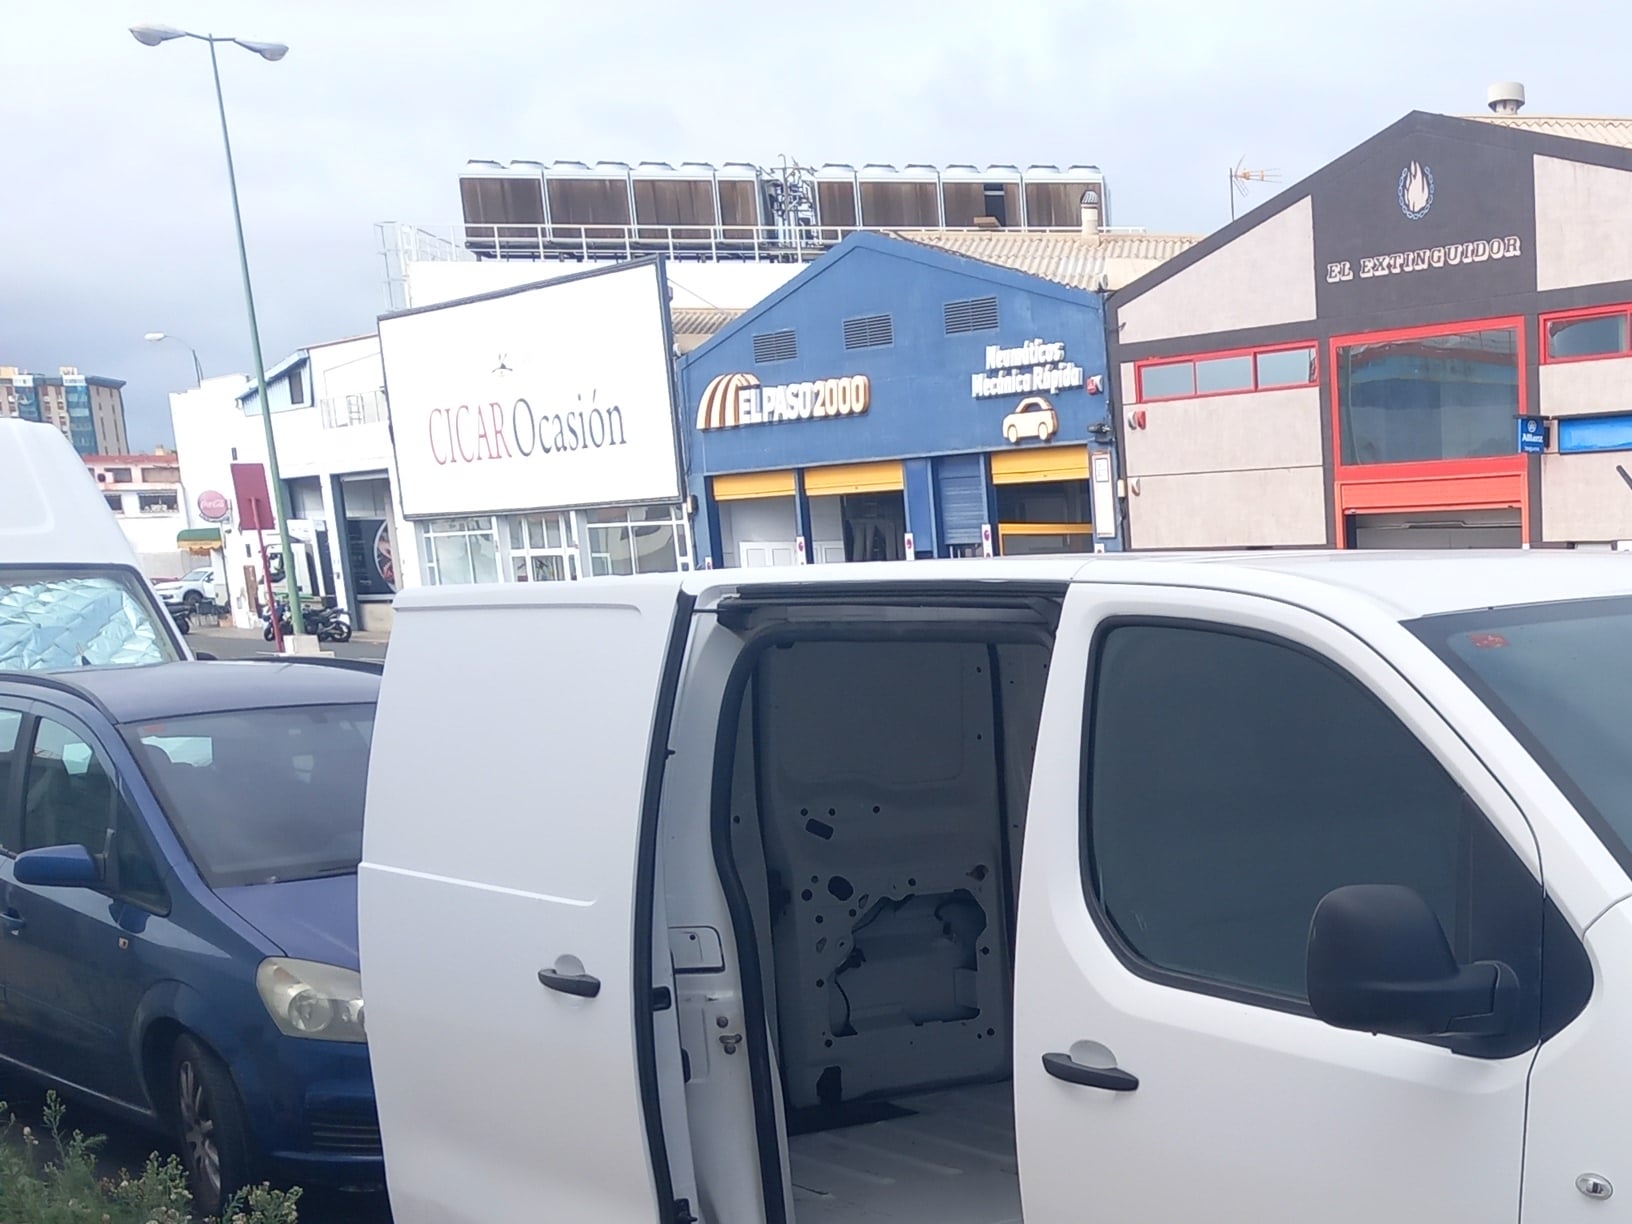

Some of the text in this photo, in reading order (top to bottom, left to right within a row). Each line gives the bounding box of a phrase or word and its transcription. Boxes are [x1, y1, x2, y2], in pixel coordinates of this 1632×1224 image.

[1326, 236, 1521, 283] EL EXTINGUIDOR
[429, 388, 627, 465] CICAR Ocasión
